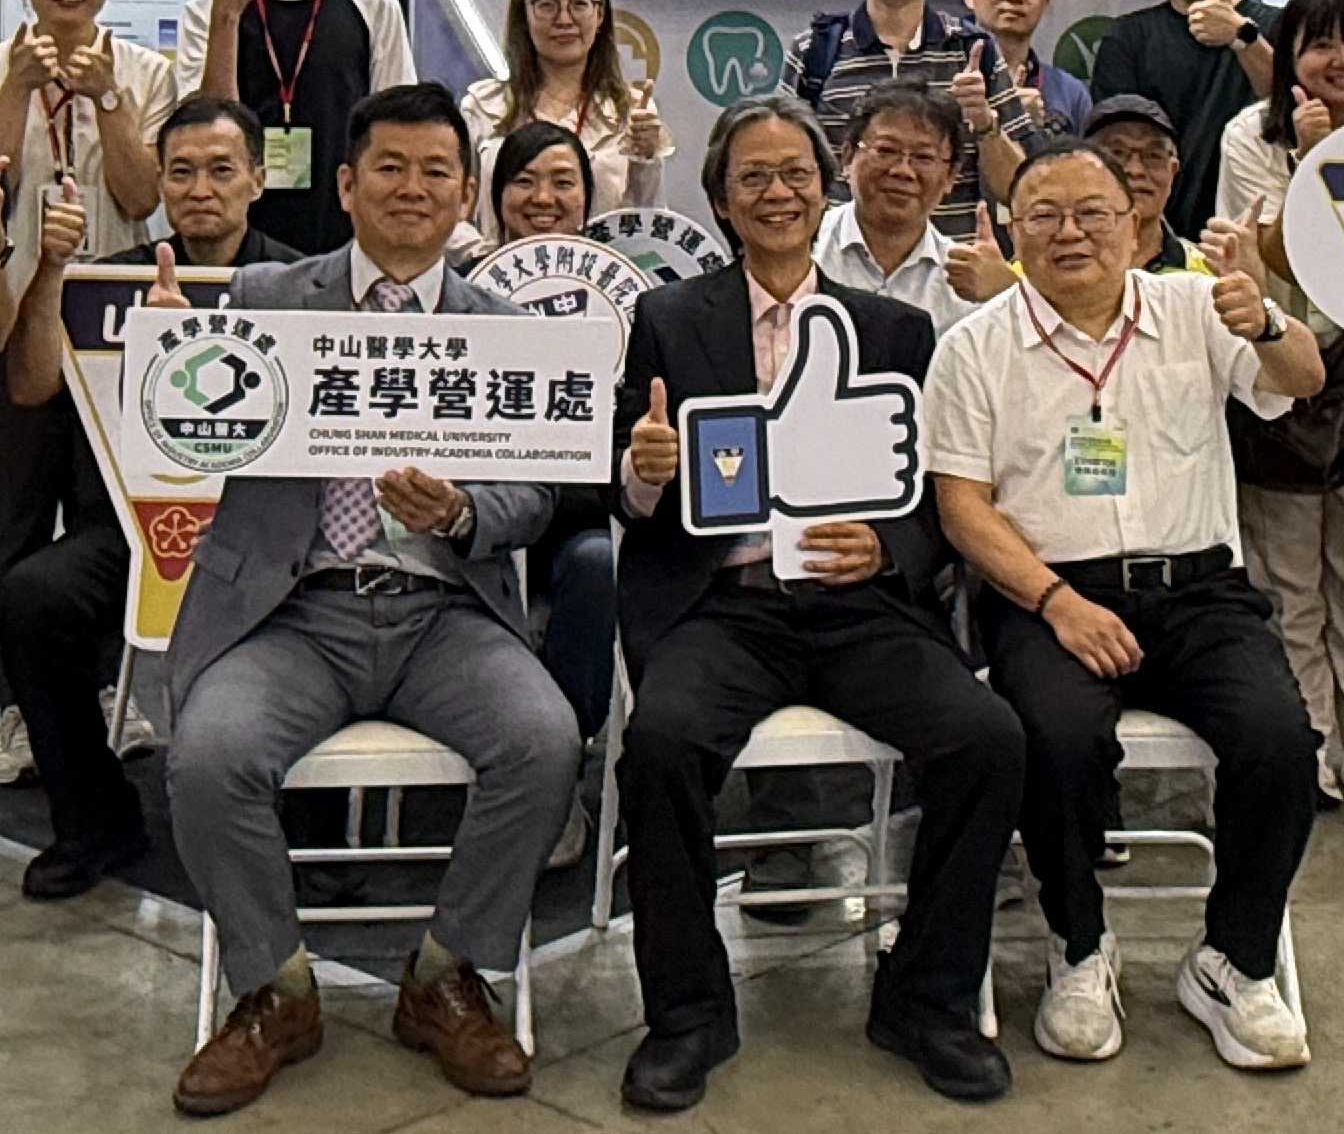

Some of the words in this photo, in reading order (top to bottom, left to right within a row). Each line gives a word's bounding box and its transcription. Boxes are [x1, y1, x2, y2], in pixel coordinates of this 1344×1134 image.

[312, 334, 468, 361] 中山醫學大學
[308, 365, 594, 422] 產學營運處
[179, 422, 248, 437] 中山醫大
[309, 428, 351, 441] CHUNG
[354, 428, 385, 441] SHAN
[389, 429, 440, 443] MEDICAL
[442, 431, 512, 444] UNIVERSITY
[194, 442, 233, 455] CSMU
[308, 445, 350, 457] OFFICE
[353, 446, 368, 457] OF
[494, 448, 592, 461] COLLABORATION
